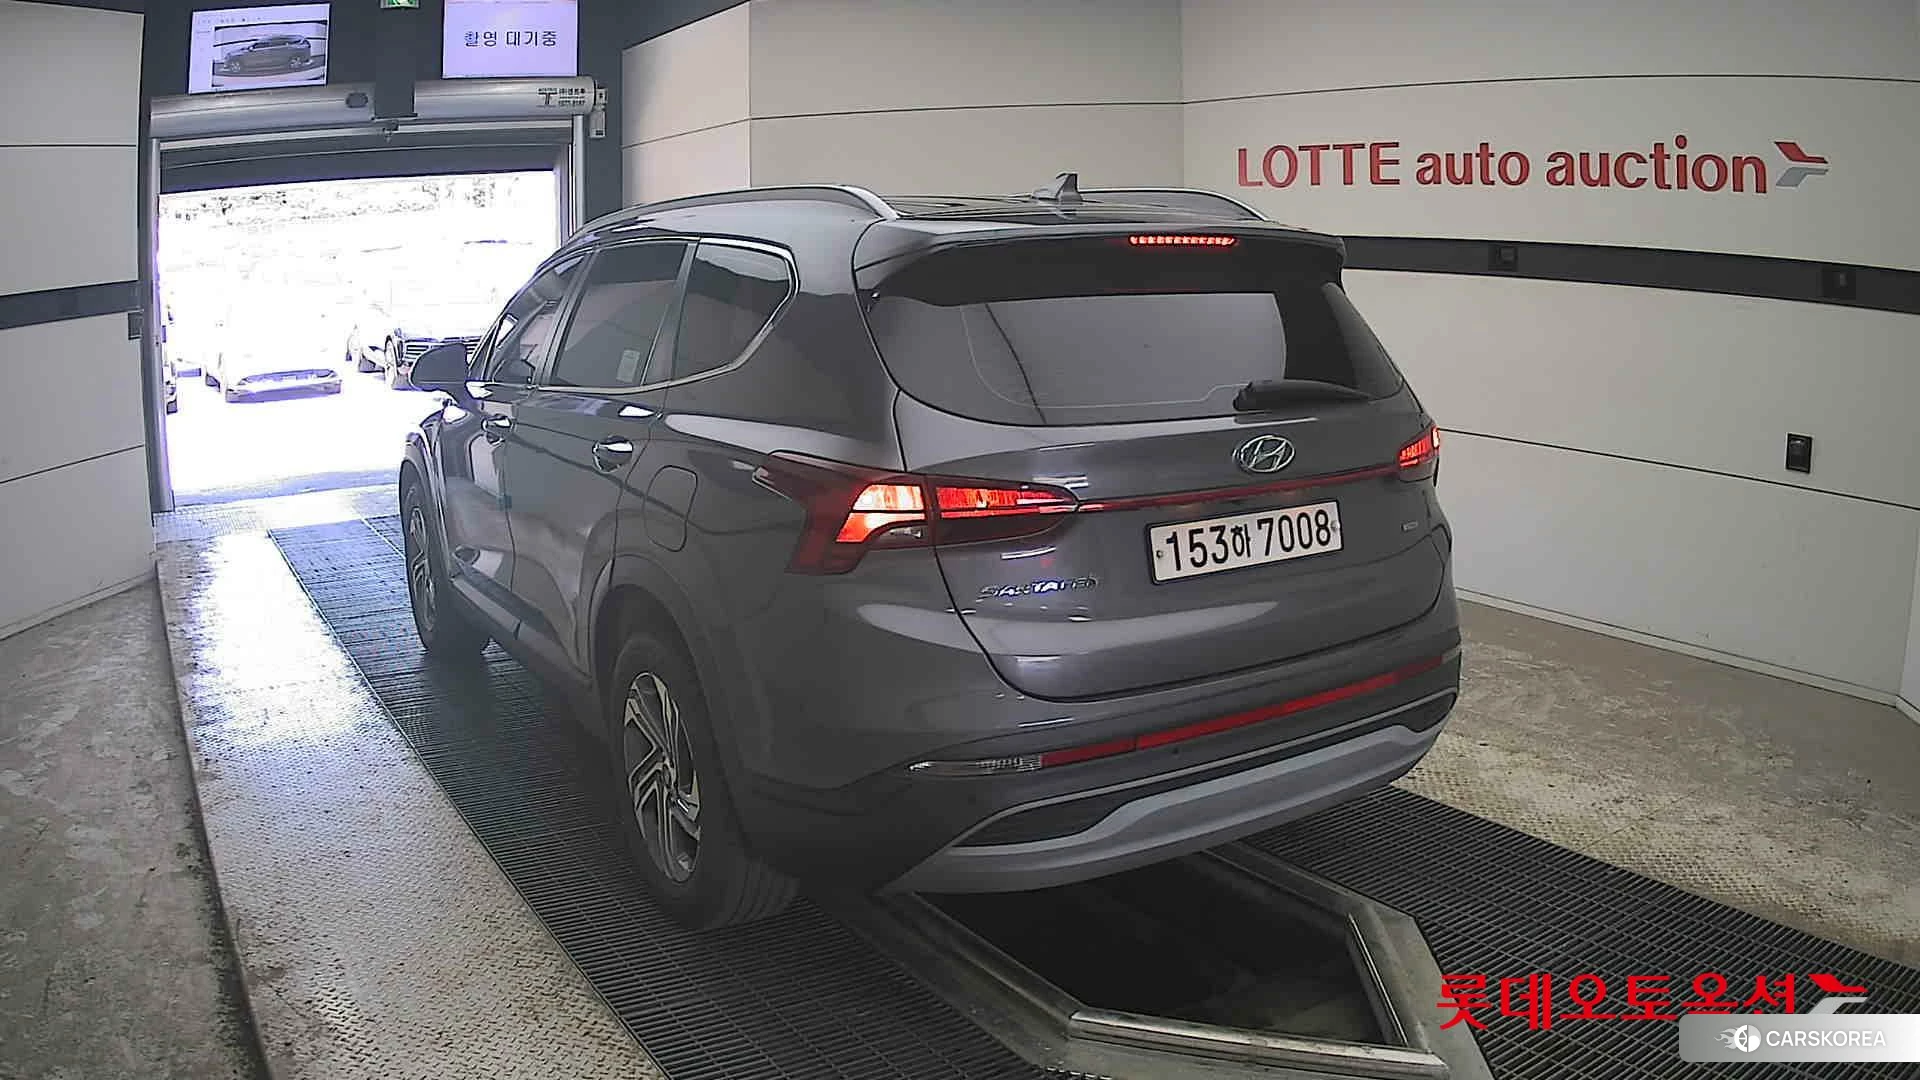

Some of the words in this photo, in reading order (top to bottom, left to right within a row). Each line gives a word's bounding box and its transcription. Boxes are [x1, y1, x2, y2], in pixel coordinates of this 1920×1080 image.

[506, 31, 557, 47] 대기중
[1237, 142, 1400, 188] LOTTE
[1416, 142, 1530, 186] auto
[1546, 134, 1767, 193] auction
[1166, 524, 1252, 571] 153하
[1257, 509, 1332, 557] 7008
